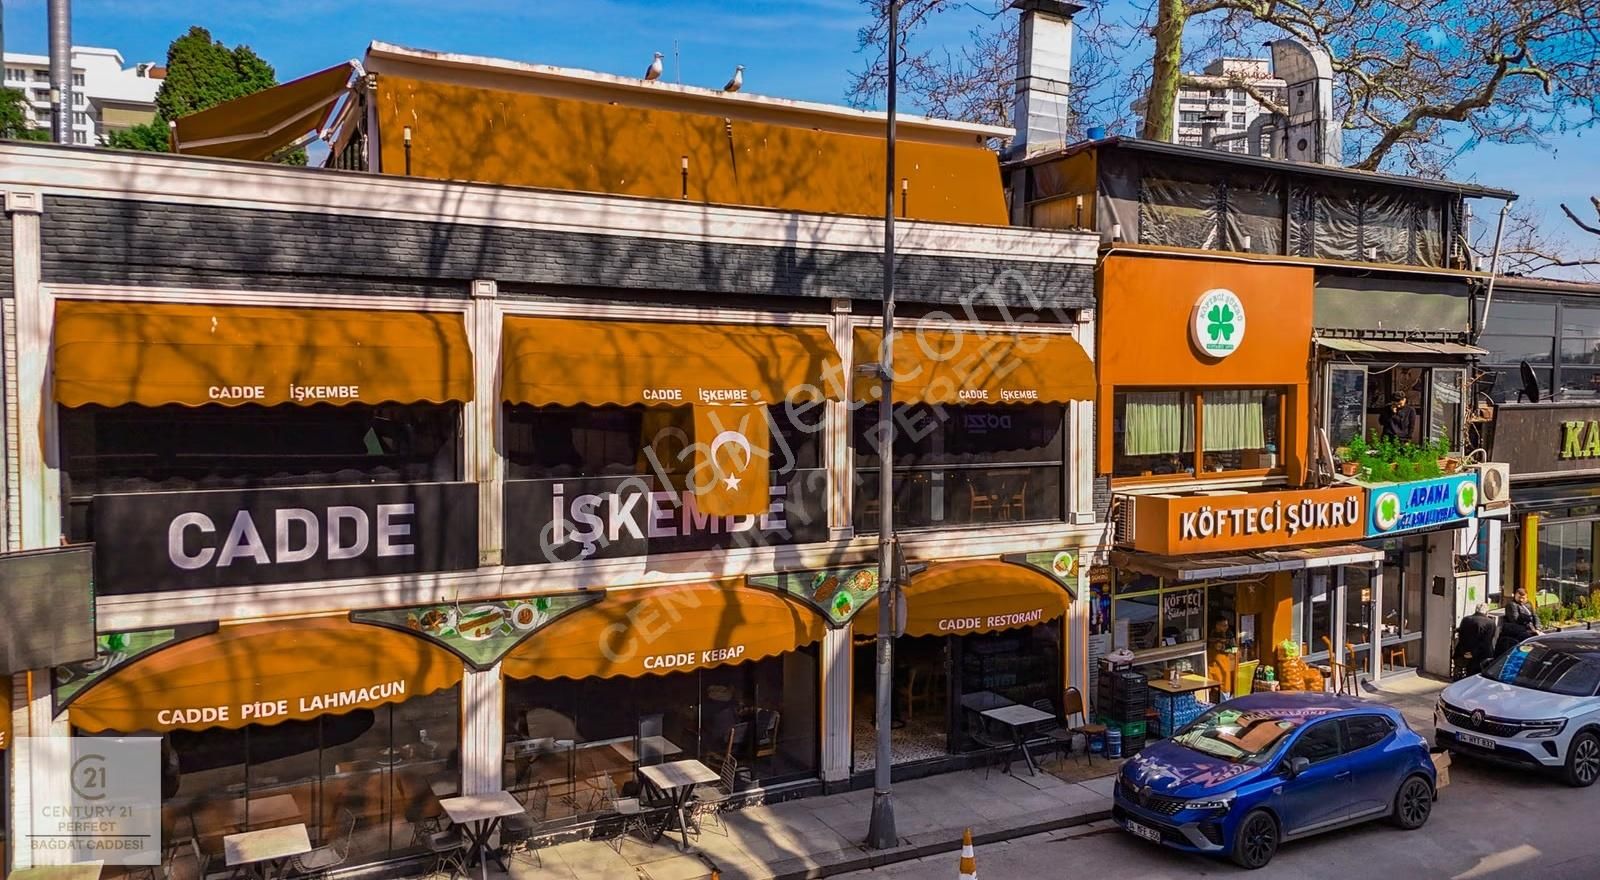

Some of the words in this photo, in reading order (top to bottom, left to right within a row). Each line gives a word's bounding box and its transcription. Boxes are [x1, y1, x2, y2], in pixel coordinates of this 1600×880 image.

[208, 386, 265, 399] CADDE
[290, 384, 360, 401] İŞKEMBE
[643, 389, 683, 400] CADDE
[699, 387, 748, 402] İŞKEMBE
[959, 389, 989, 399] CADDE
[1000, 388, 1038, 400] İŞKEMBE
[1182, 499, 1282, 538] KÖFTECİ
[1286, 496, 1359, 535] ŞÜKRÜ
[168, 503, 415, 570] CADDE
[938, 618, 981, 630] CADDE
[986, 608, 1043, 628] RESTORANT
[643, 652, 696, 669] CADDE
[701, 645, 745, 663] KEBAP
[157, 706, 229, 725] CADDE
[241, 700, 288, 720] PİDE
[299, 680, 405, 713] LAHMACUN
